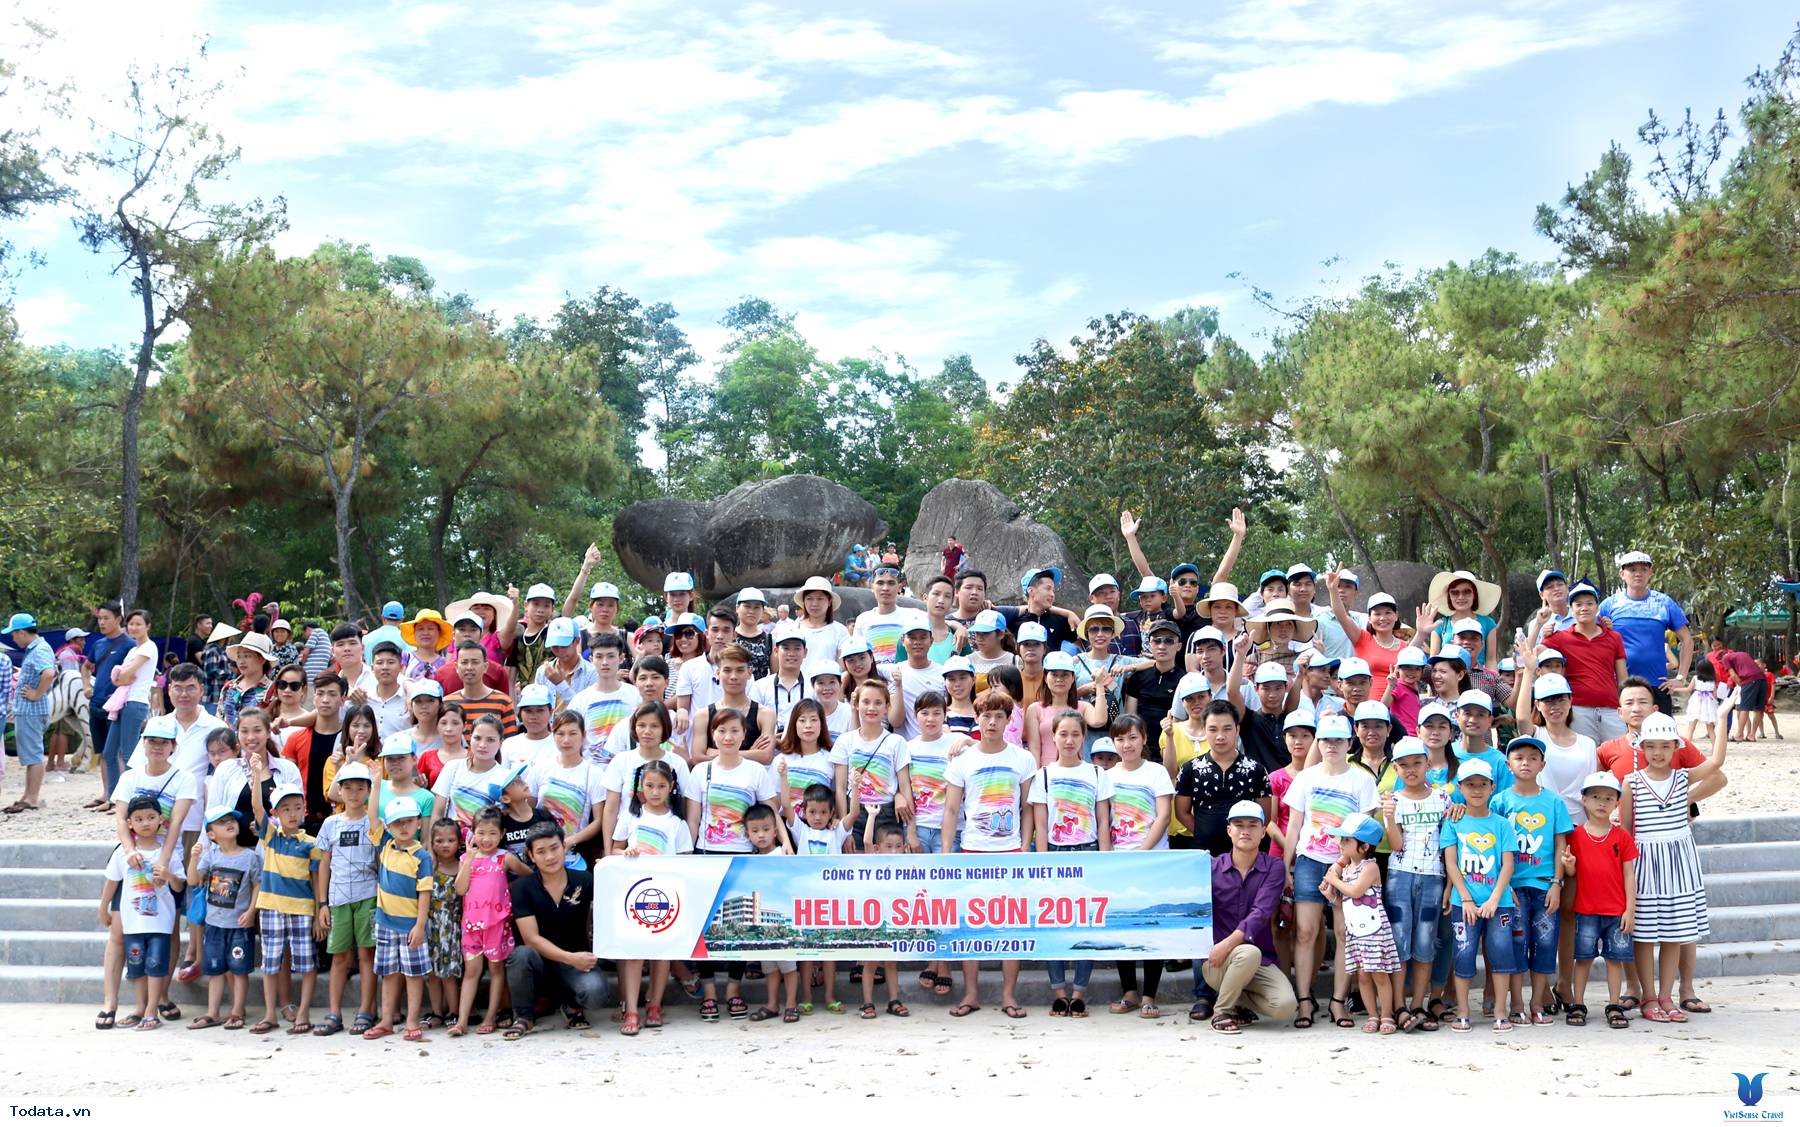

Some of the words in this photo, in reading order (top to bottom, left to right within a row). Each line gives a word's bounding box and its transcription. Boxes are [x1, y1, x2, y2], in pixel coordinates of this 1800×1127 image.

[822, 866, 855, 881] CÔNG
[858, 868, 872, 881] TY
[929, 866, 962, 880] CÔNG
[966, 865, 1008, 882] NGHIỆP
[1011, 867, 1025, 879] JK
[1057, 866, 1083, 878] NAM
[1460, 853, 1496, 875] my
[794, 898, 881, 926] HELLO
[891, 888, 957, 926] SẦM
[967, 895, 1028, 925] SƠN
[1037, 896, 1109, 925] 2017
[891, 940, 936, 953] 10/06
[951, 940, 1036, 952] 11/06/2017
